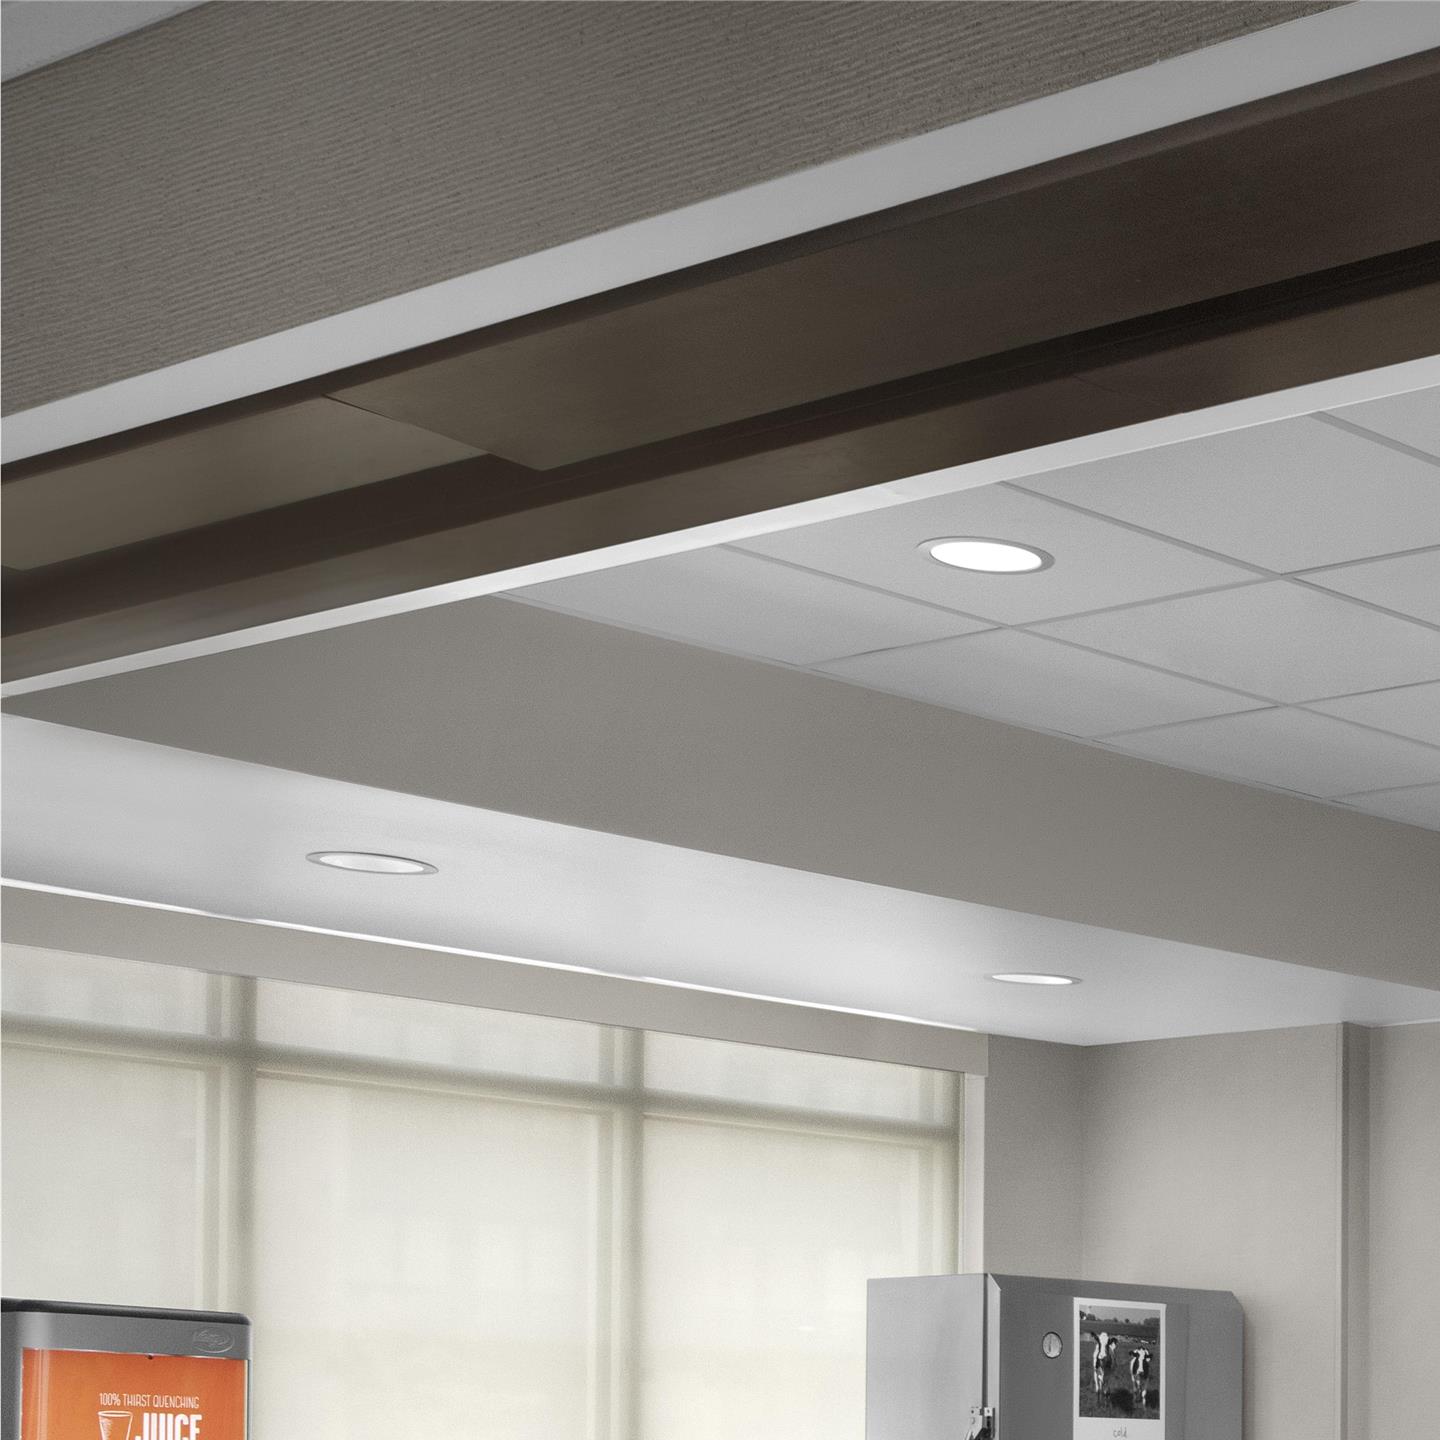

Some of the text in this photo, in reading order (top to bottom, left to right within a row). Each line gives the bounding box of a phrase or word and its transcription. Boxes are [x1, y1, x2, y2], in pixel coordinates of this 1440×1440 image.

[99, 1392, 200, 1409] 100% THIRST QUENCHING
